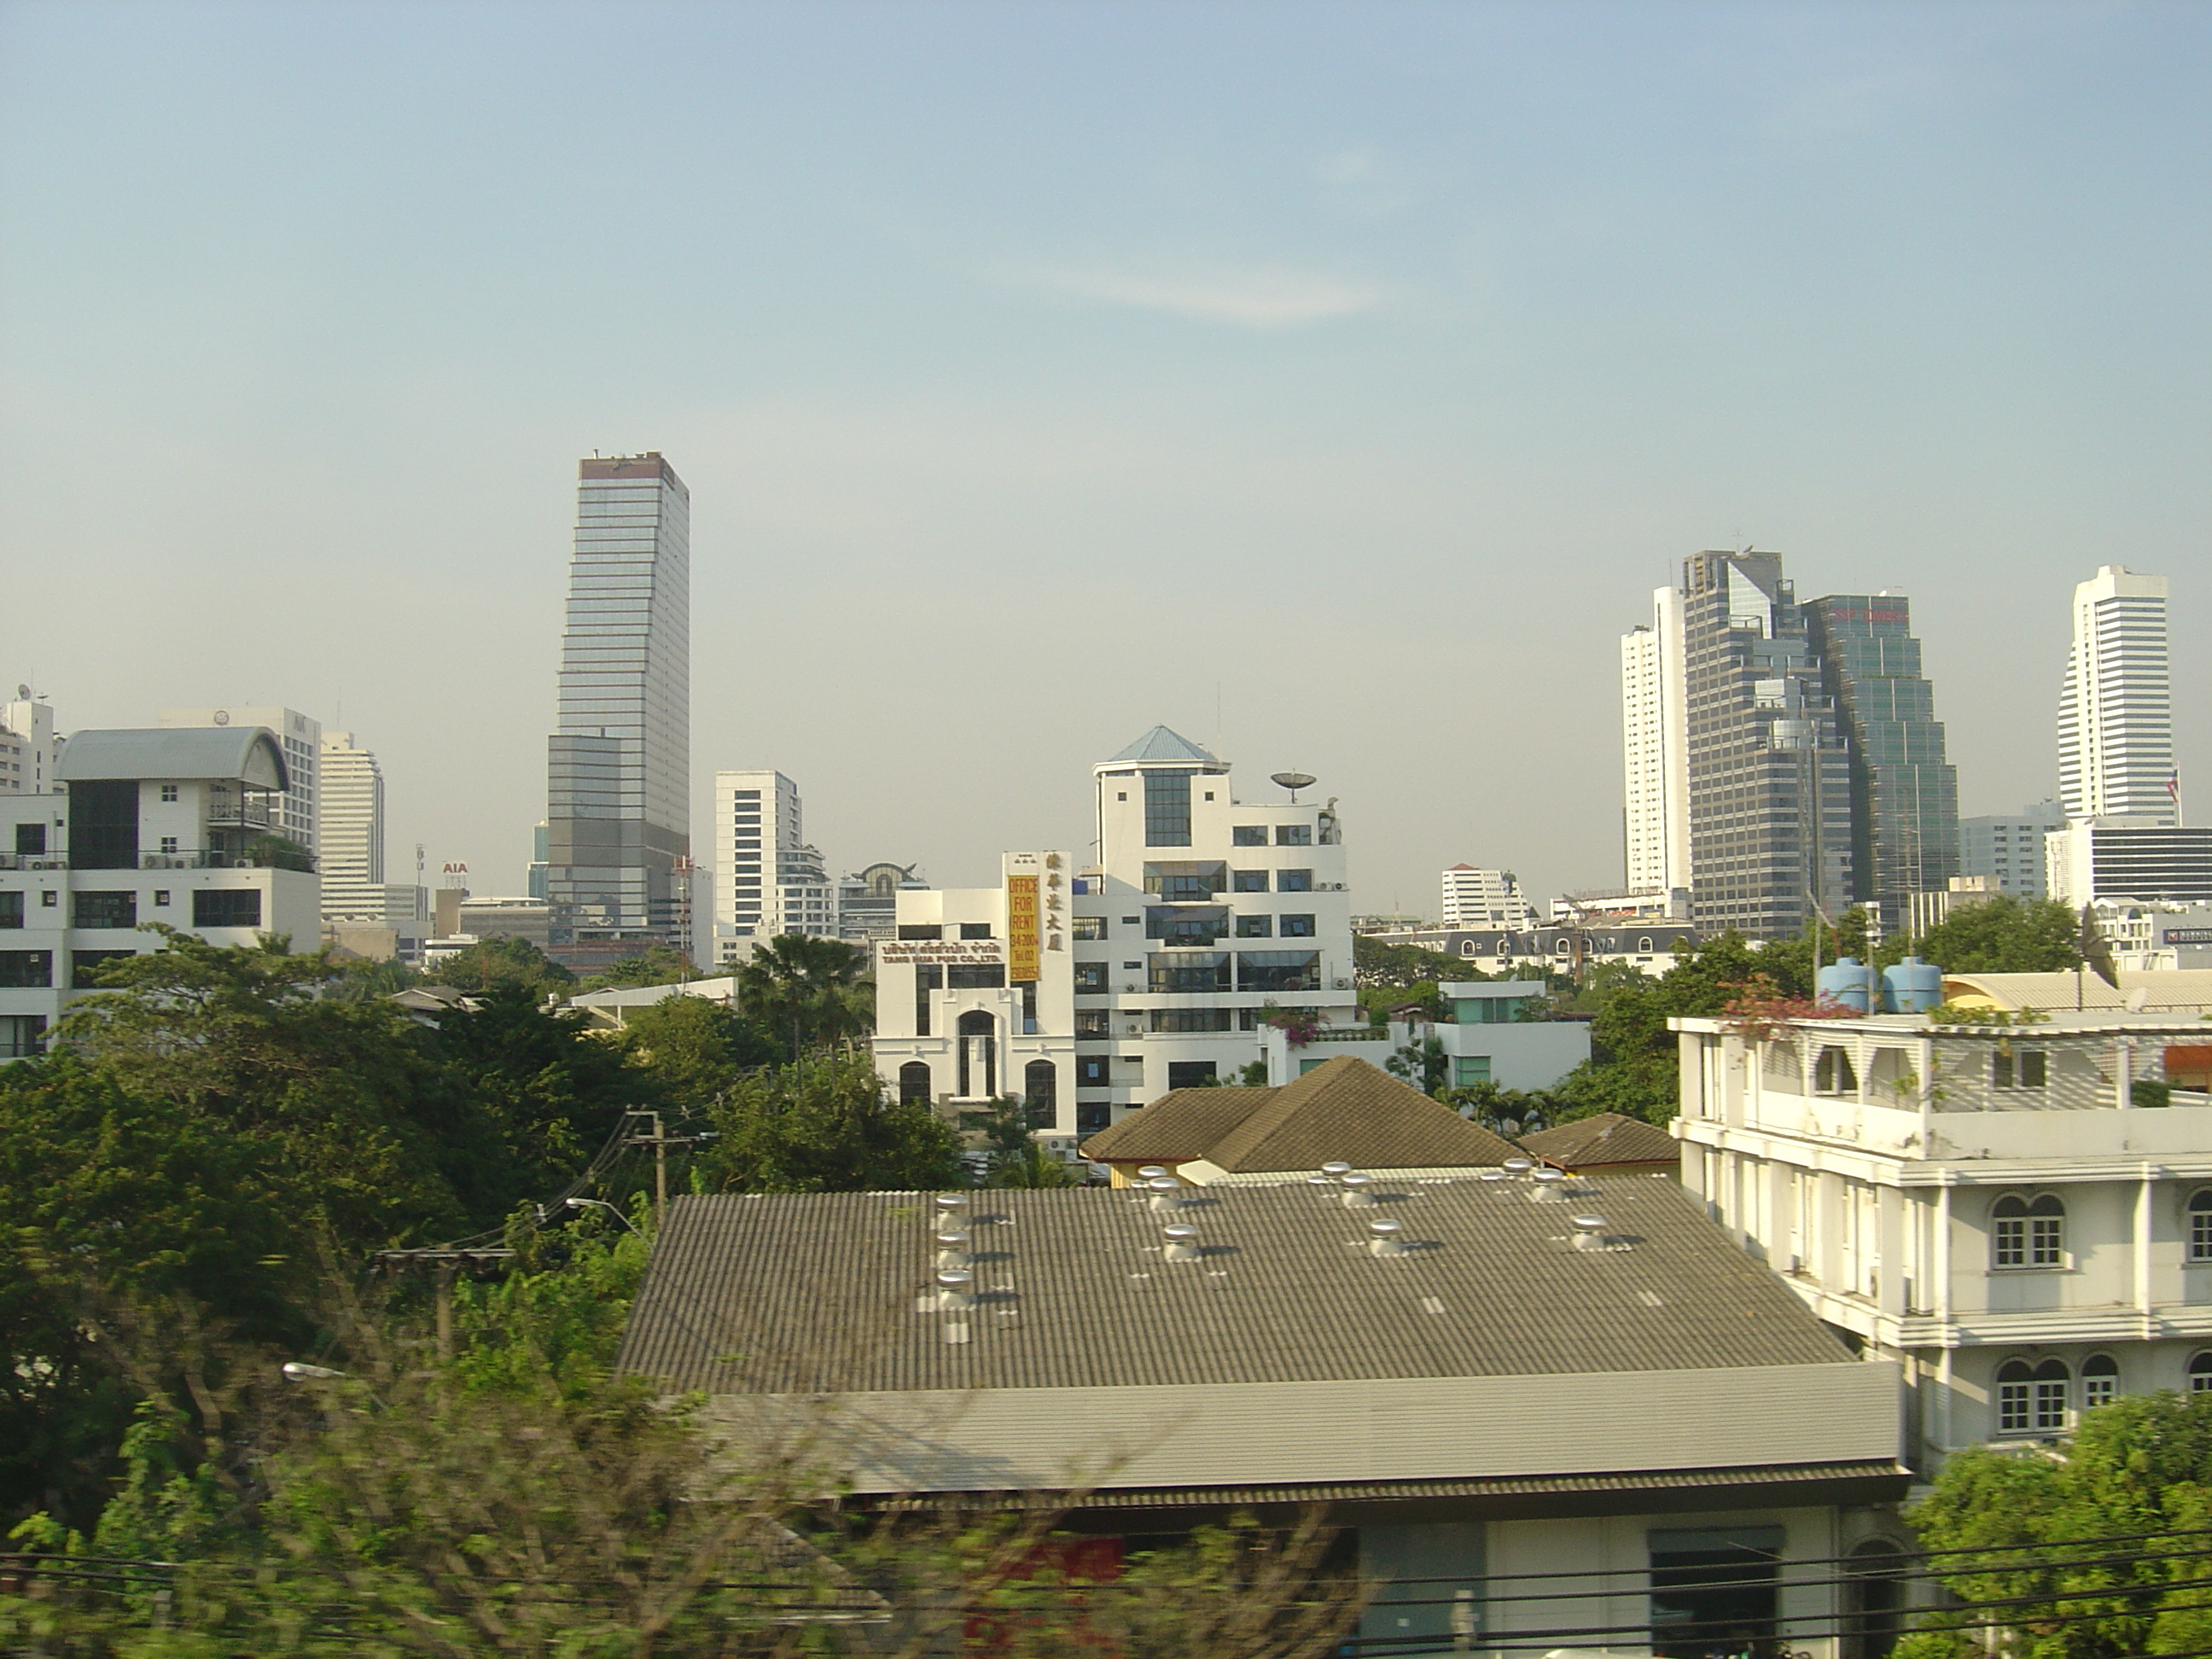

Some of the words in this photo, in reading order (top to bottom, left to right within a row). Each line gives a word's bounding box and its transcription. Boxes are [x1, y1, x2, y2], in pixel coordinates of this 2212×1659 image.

[1834, 608, 1856, 621] SSP
[443, 863, 468, 873] AIA
[1010, 878, 1038, 894] OFFICE
[1014, 897, 1033, 911] FOR
[1012, 915, 1034, 929] RENT
[882, 943, 917, 955] บริษัท
[970, 941, 1001, 953] จำกัด
